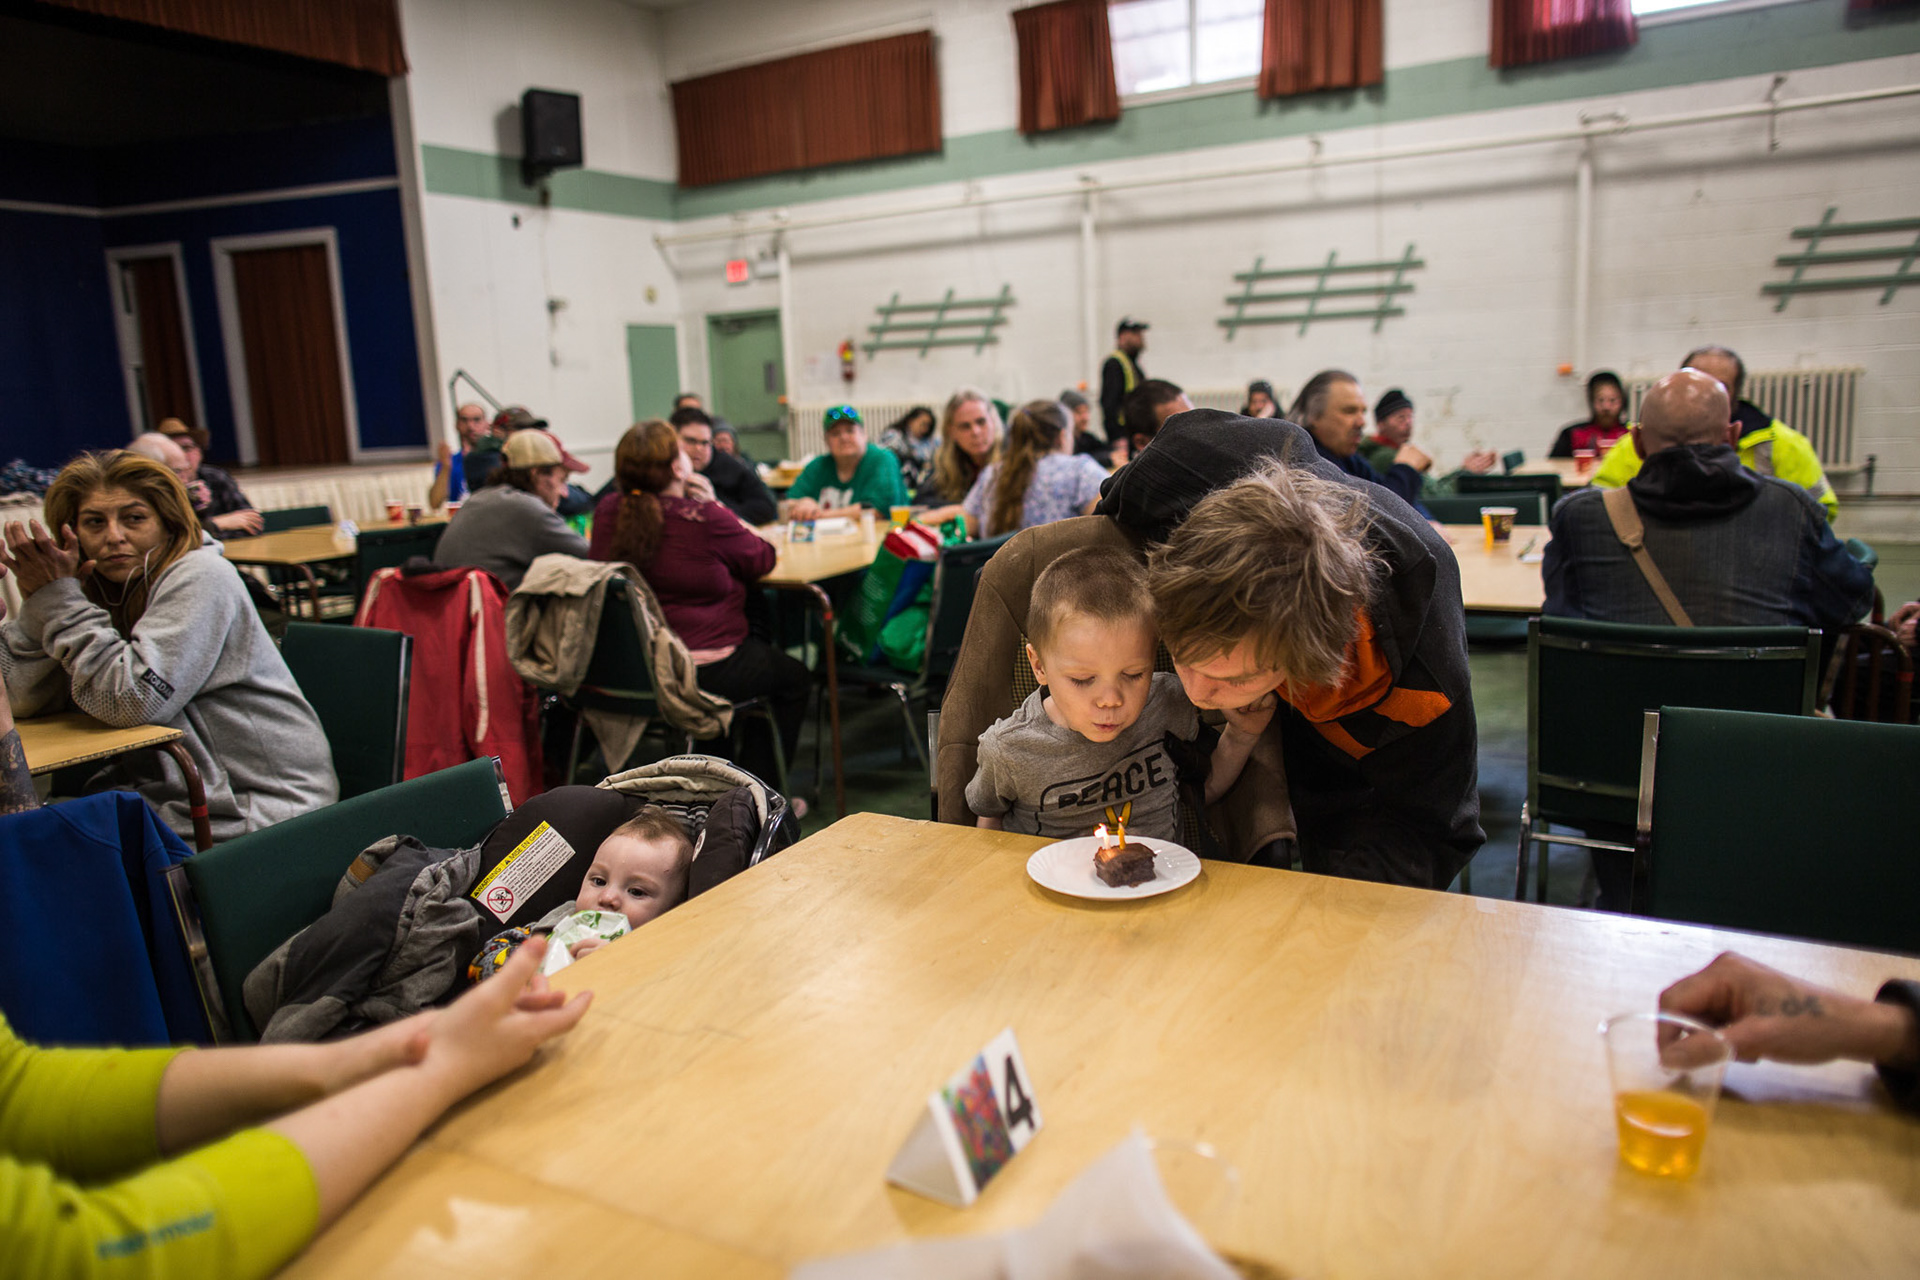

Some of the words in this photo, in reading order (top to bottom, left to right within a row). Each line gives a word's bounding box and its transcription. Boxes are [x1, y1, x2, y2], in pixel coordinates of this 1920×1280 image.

[1058, 752, 1167, 809] PEACE
[477, 866, 502, 894] WARNING
[508, 846, 522, 860] MISE
[520, 840, 530, 850] EN
[529, 824, 547, 842] GARDE
[1005, 1053, 1035, 1131] 4
